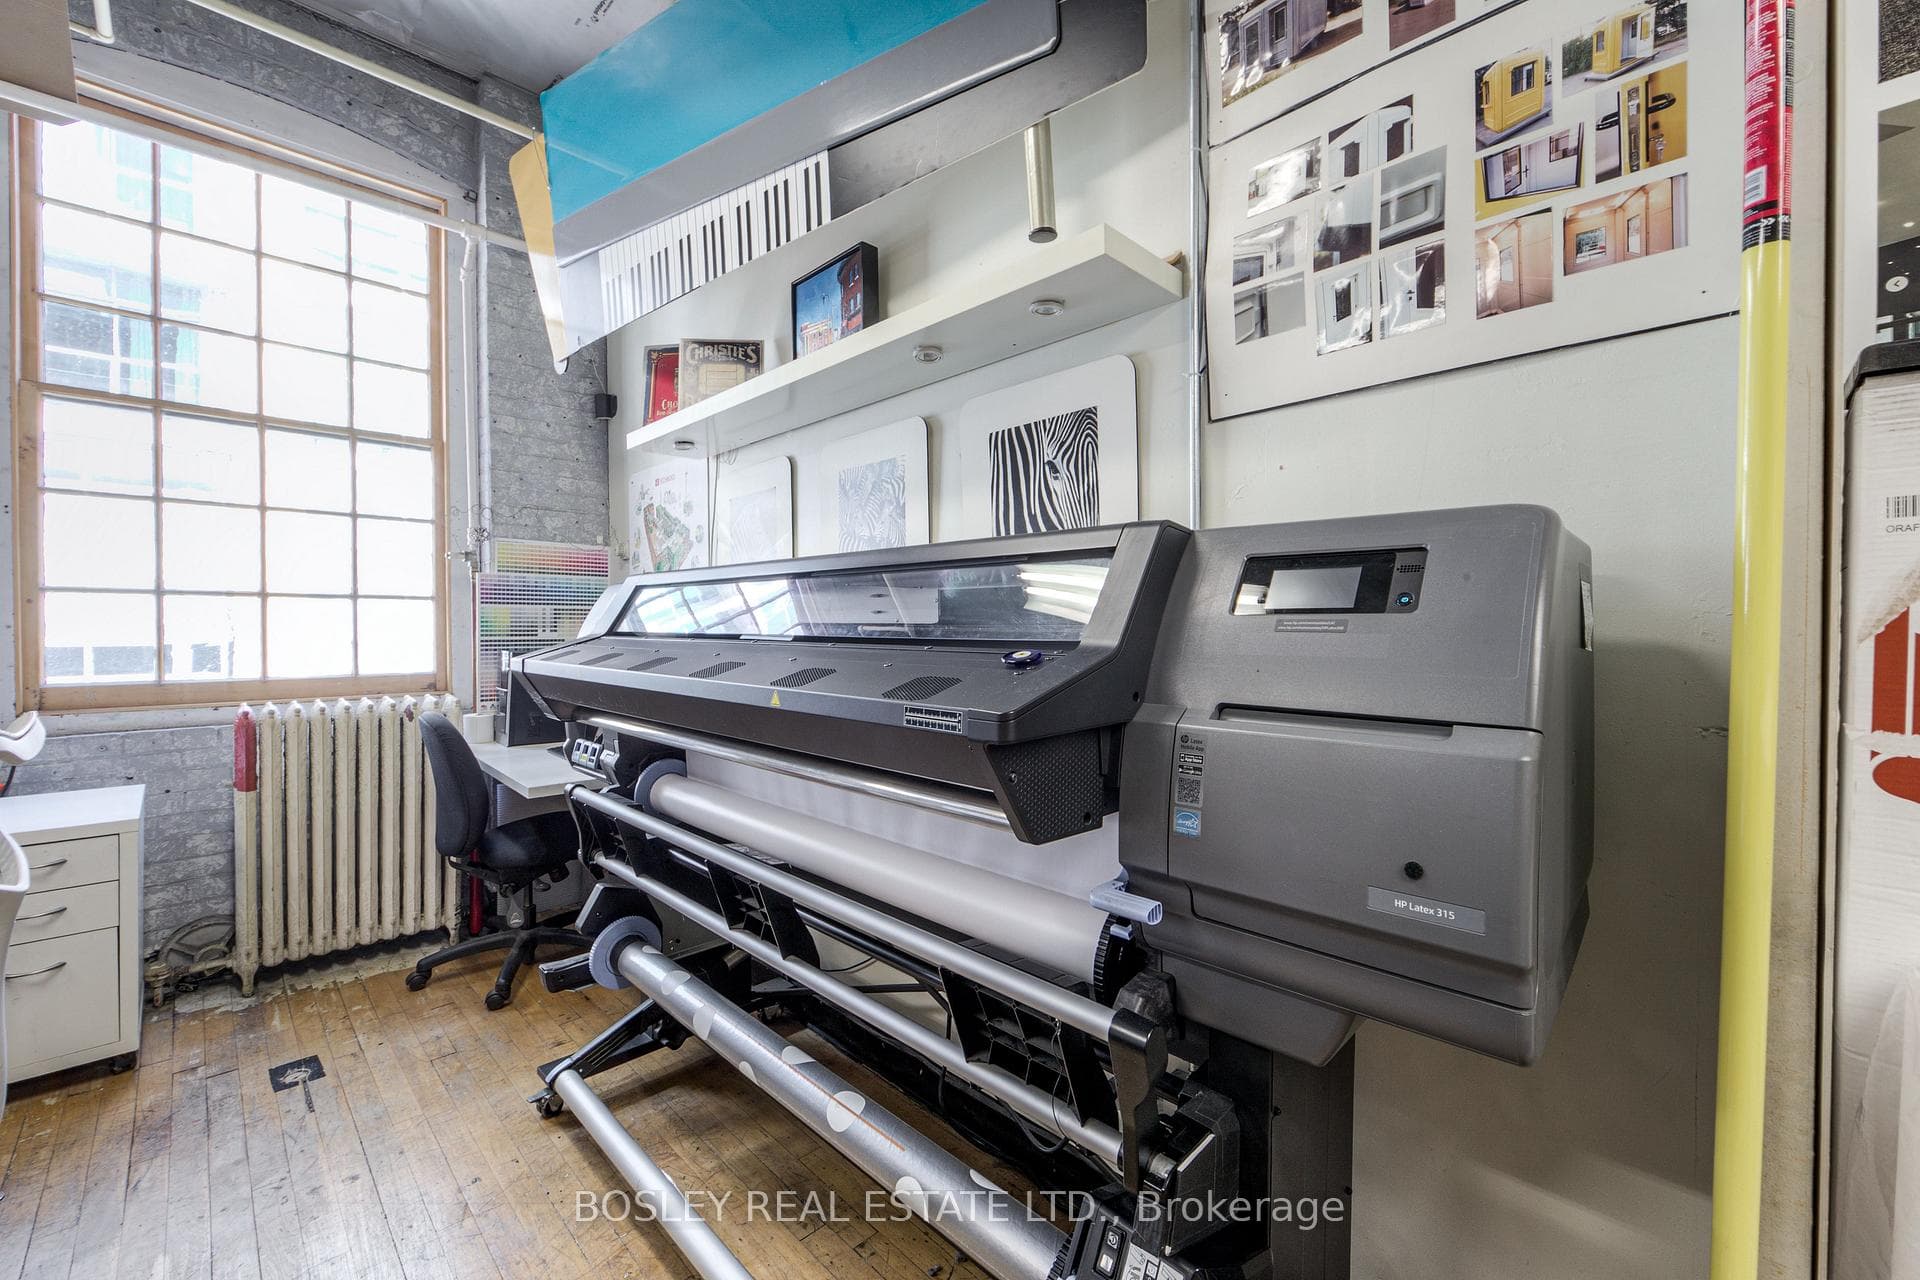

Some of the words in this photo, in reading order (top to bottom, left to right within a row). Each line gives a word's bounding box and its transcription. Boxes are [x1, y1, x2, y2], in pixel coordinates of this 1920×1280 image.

[685, 343, 758, 365] CHRISTIE'S
[1885, 523, 1920, 533] ORAF
[1394, 899, 1408, 909] HP
[1409, 902, 1435, 915] Latex
[1436, 908, 1455, 920] 315
